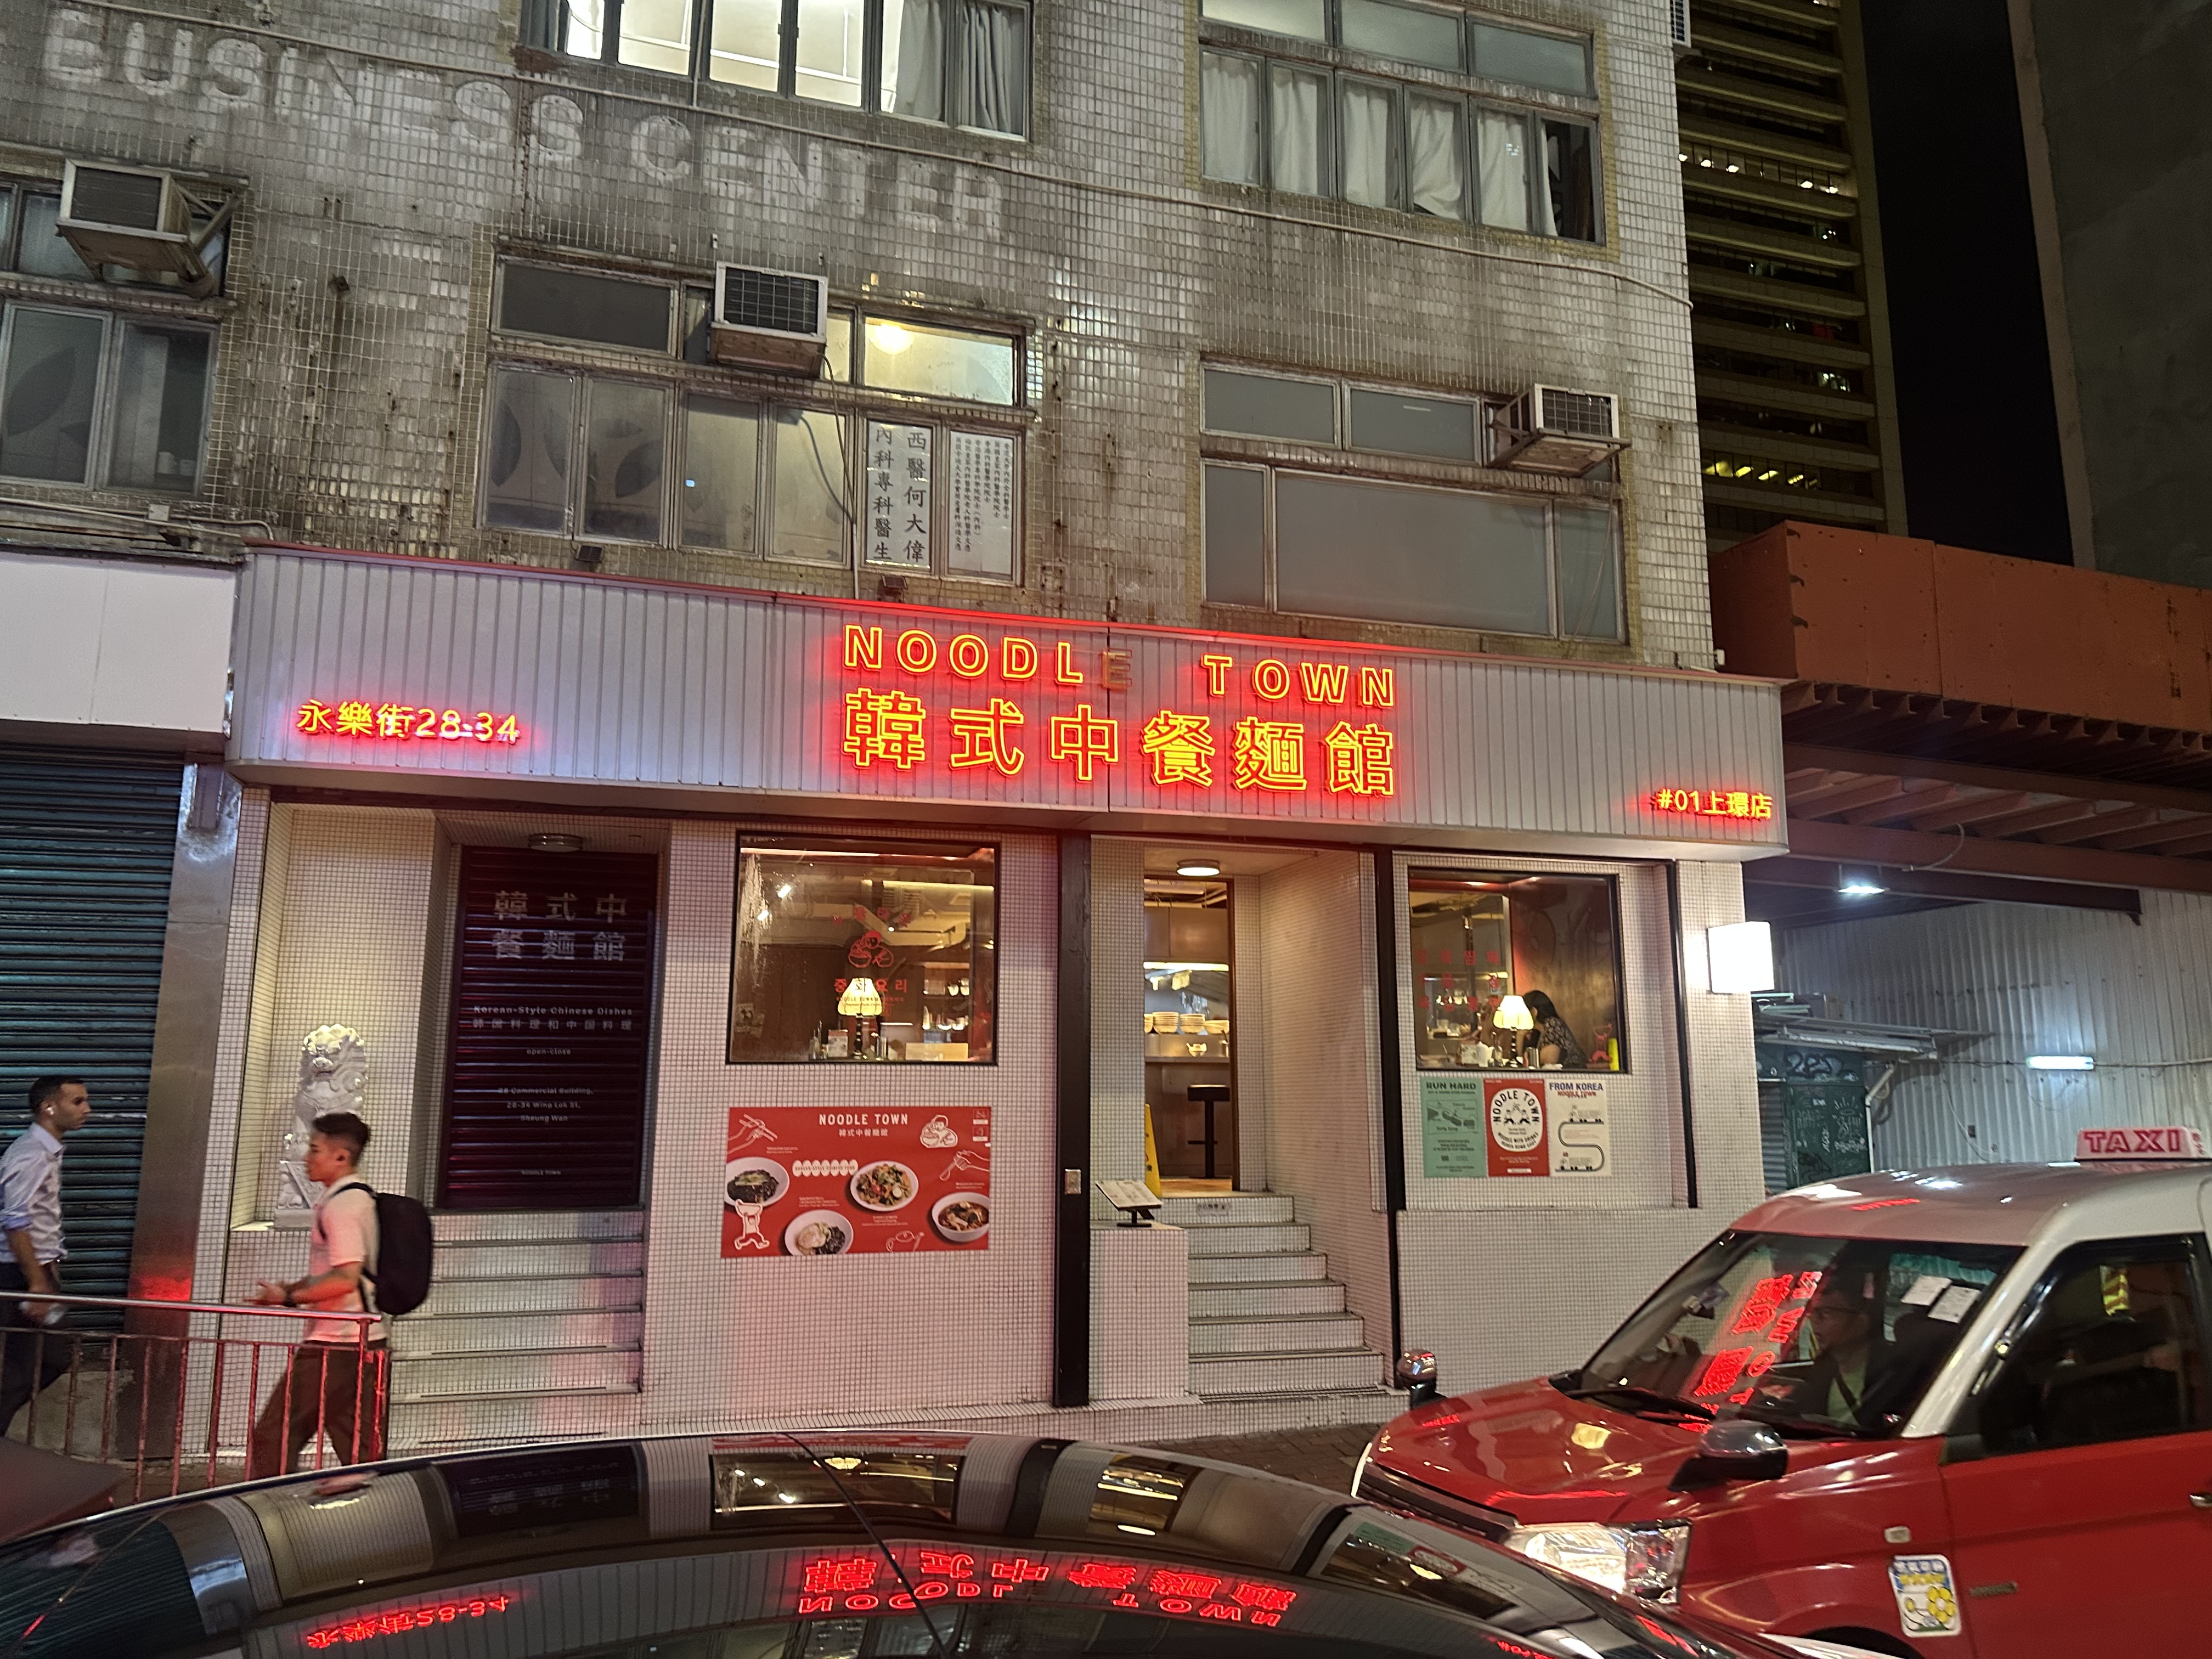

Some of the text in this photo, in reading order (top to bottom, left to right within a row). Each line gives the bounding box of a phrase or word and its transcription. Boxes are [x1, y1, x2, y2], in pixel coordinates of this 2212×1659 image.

[43, 8, 584, 163] BUSINESS
[904, 432, 927, 562] 西醫何大偉
[844, 624, 1395, 708] NOODLE TOWN
[843, 687, 1396, 797] 韓式中餐麵館
[1657, 788, 1773, 820] #01上環店
[494, 890, 628, 923] 韓式中
[473, 1006, 633, 1015] Korean-Style Chinese Dishes
[1426, 1081, 1476, 1090] RUN HARD
[1549, 1082, 1604, 1091] FROM KOREA
[819, 1113, 909, 1125] NOODLE TOWN
[1492, 1090, 1540, 1122] NOODLE TOWN
[2083, 1129, 2181, 1153] TAXI
